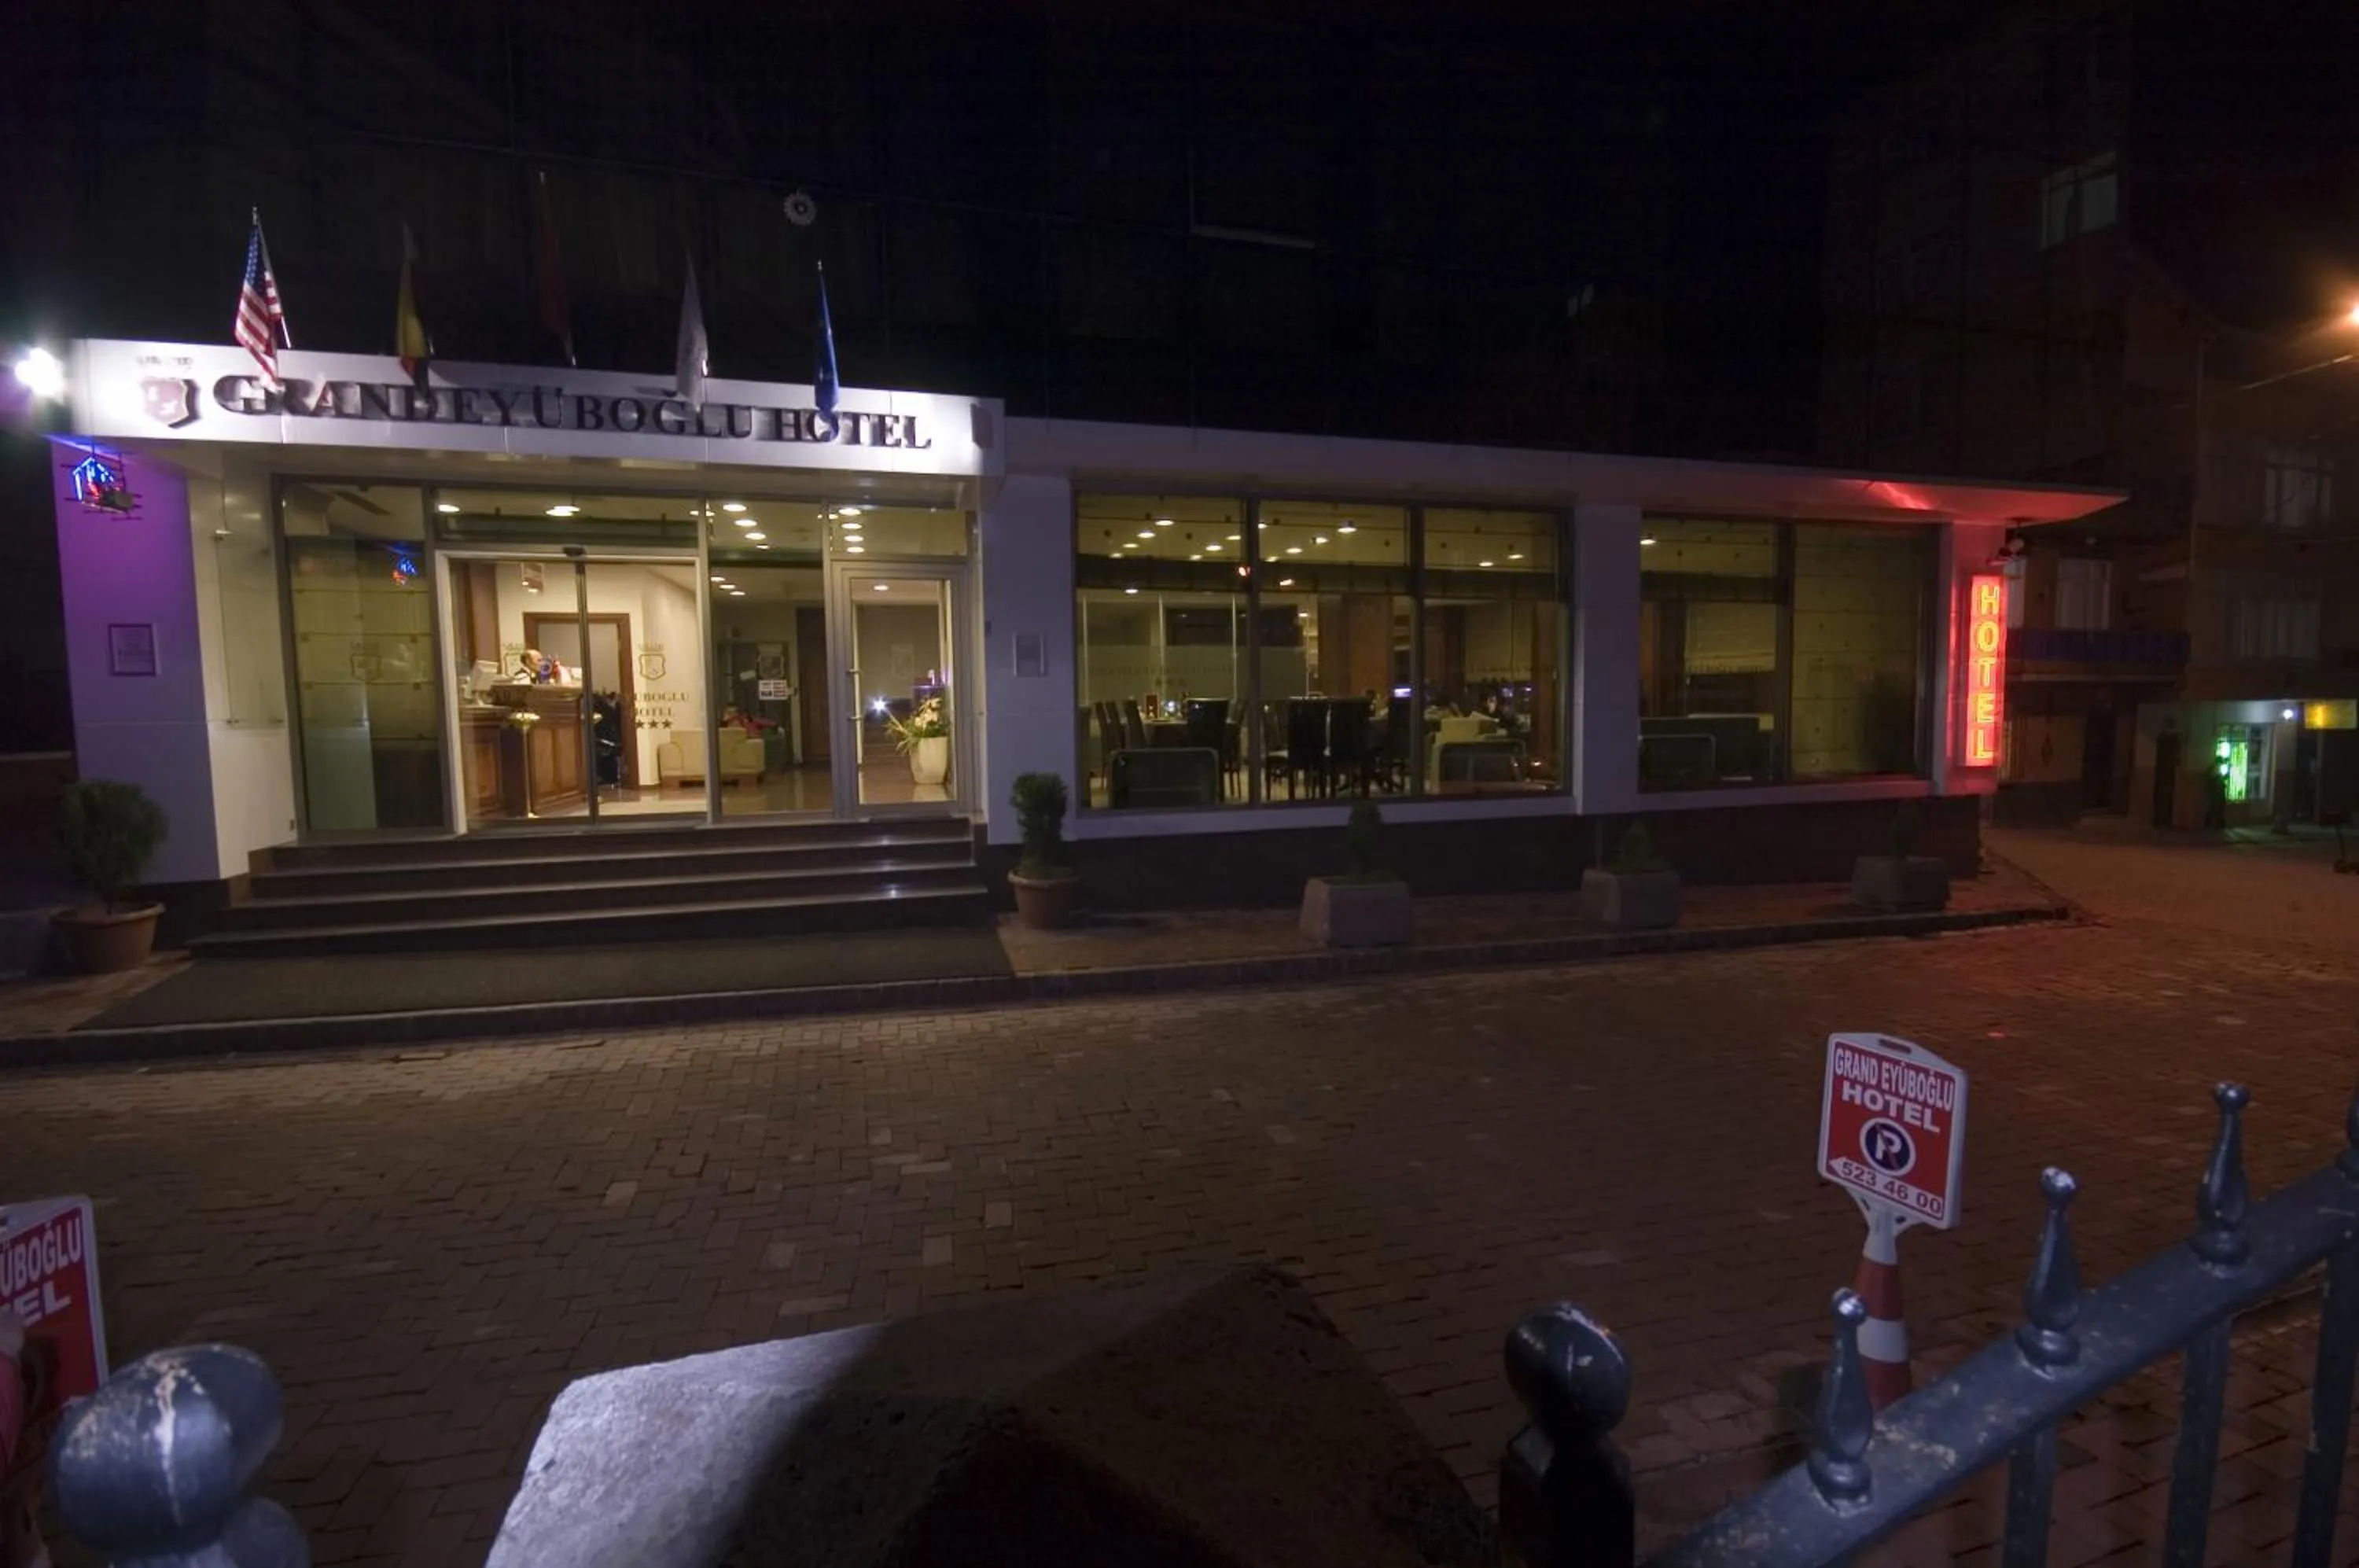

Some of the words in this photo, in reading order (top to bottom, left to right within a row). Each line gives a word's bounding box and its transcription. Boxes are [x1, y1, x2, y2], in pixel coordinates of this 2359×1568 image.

[213, 375, 438, 421] GRAND
[773, 407, 932, 448] HOTEL
[1974, 584, 2000, 760] HOTEL
[1835, 1048, 1878, 1086] GRAND
[1842, 1080, 1940, 1133] HOTEL
[1842, 1161, 1877, 1186] 523
[1883, 1180, 1908, 1200] 46
[1916, 1194, 1941, 1213] 00
